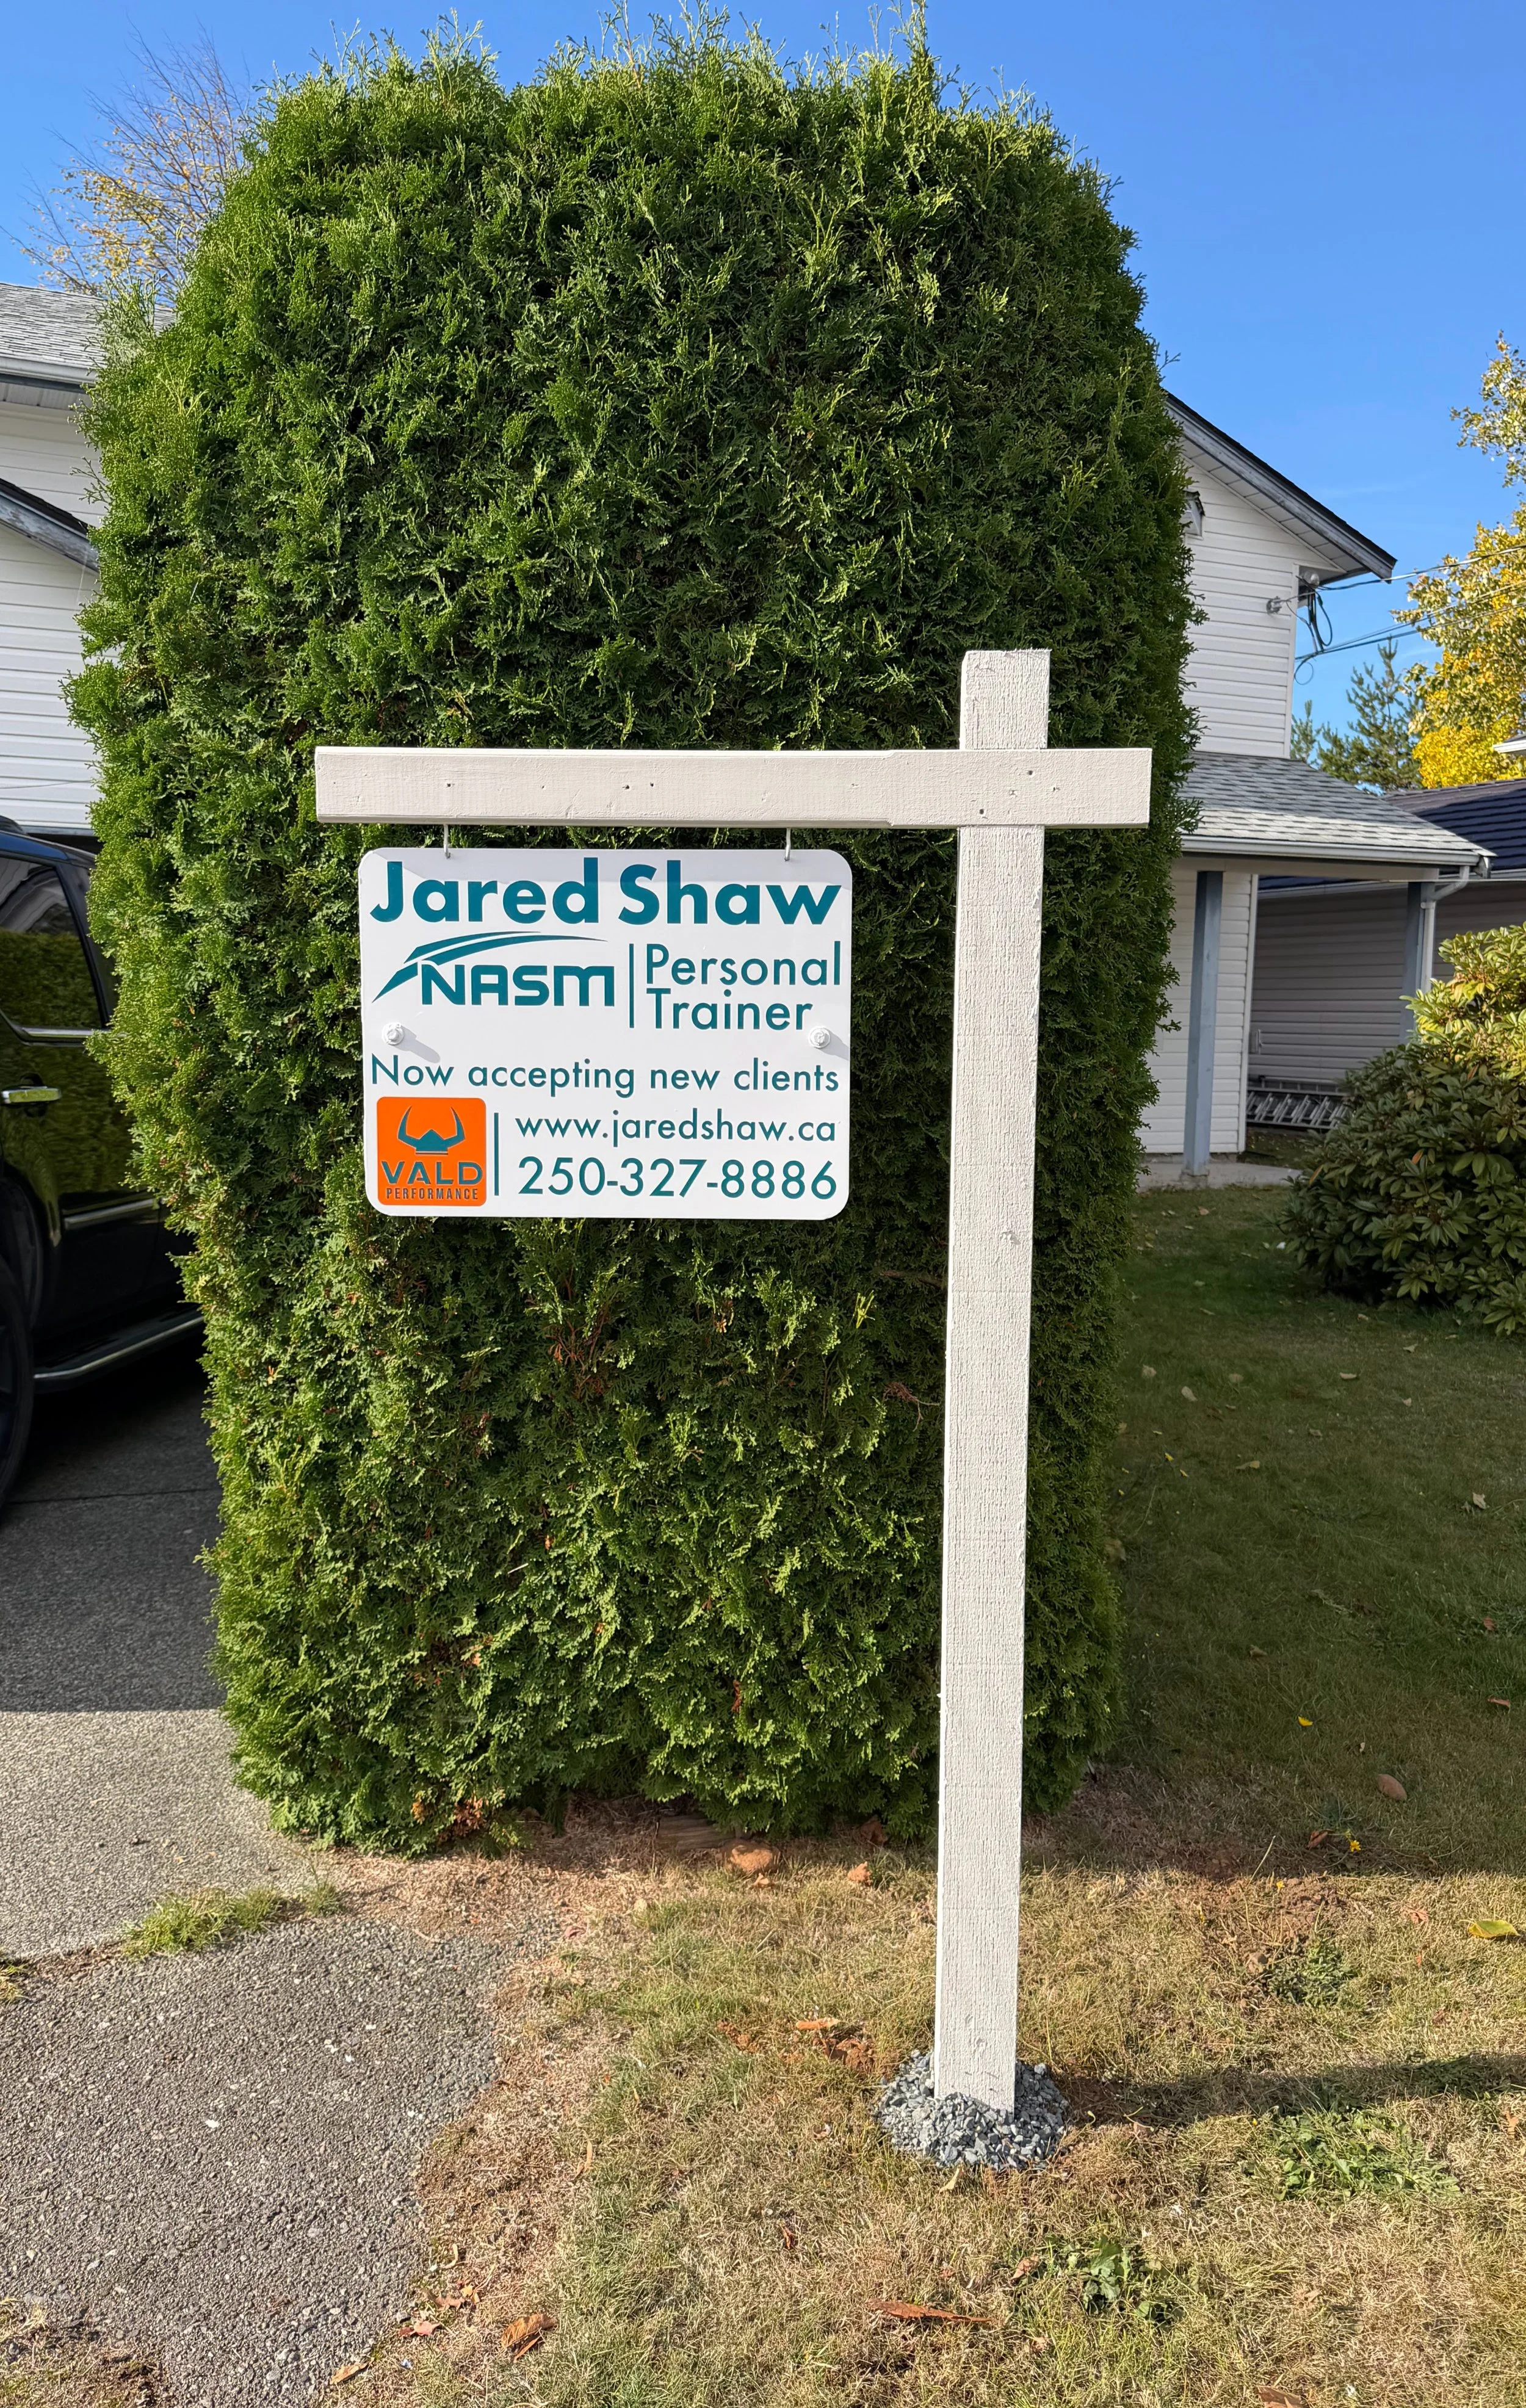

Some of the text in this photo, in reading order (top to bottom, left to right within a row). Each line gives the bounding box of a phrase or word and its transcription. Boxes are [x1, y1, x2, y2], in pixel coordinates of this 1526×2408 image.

[371, 857, 841, 926] Jared Shaw
[421, 962, 615, 1007] NASM
[646, 941, 841, 986] Personal
[646, 988, 812, 1030] Trainer
[371, 1055, 839, 1098] Now accepting new clients
[515, 1108, 836, 1146] www.jaredshaw.ca
[381, 1161, 483, 1185] VALD
[386, 1188, 479, 1200] PERFORMANCE
[519, 1156, 836, 1199] 250-327-8886
